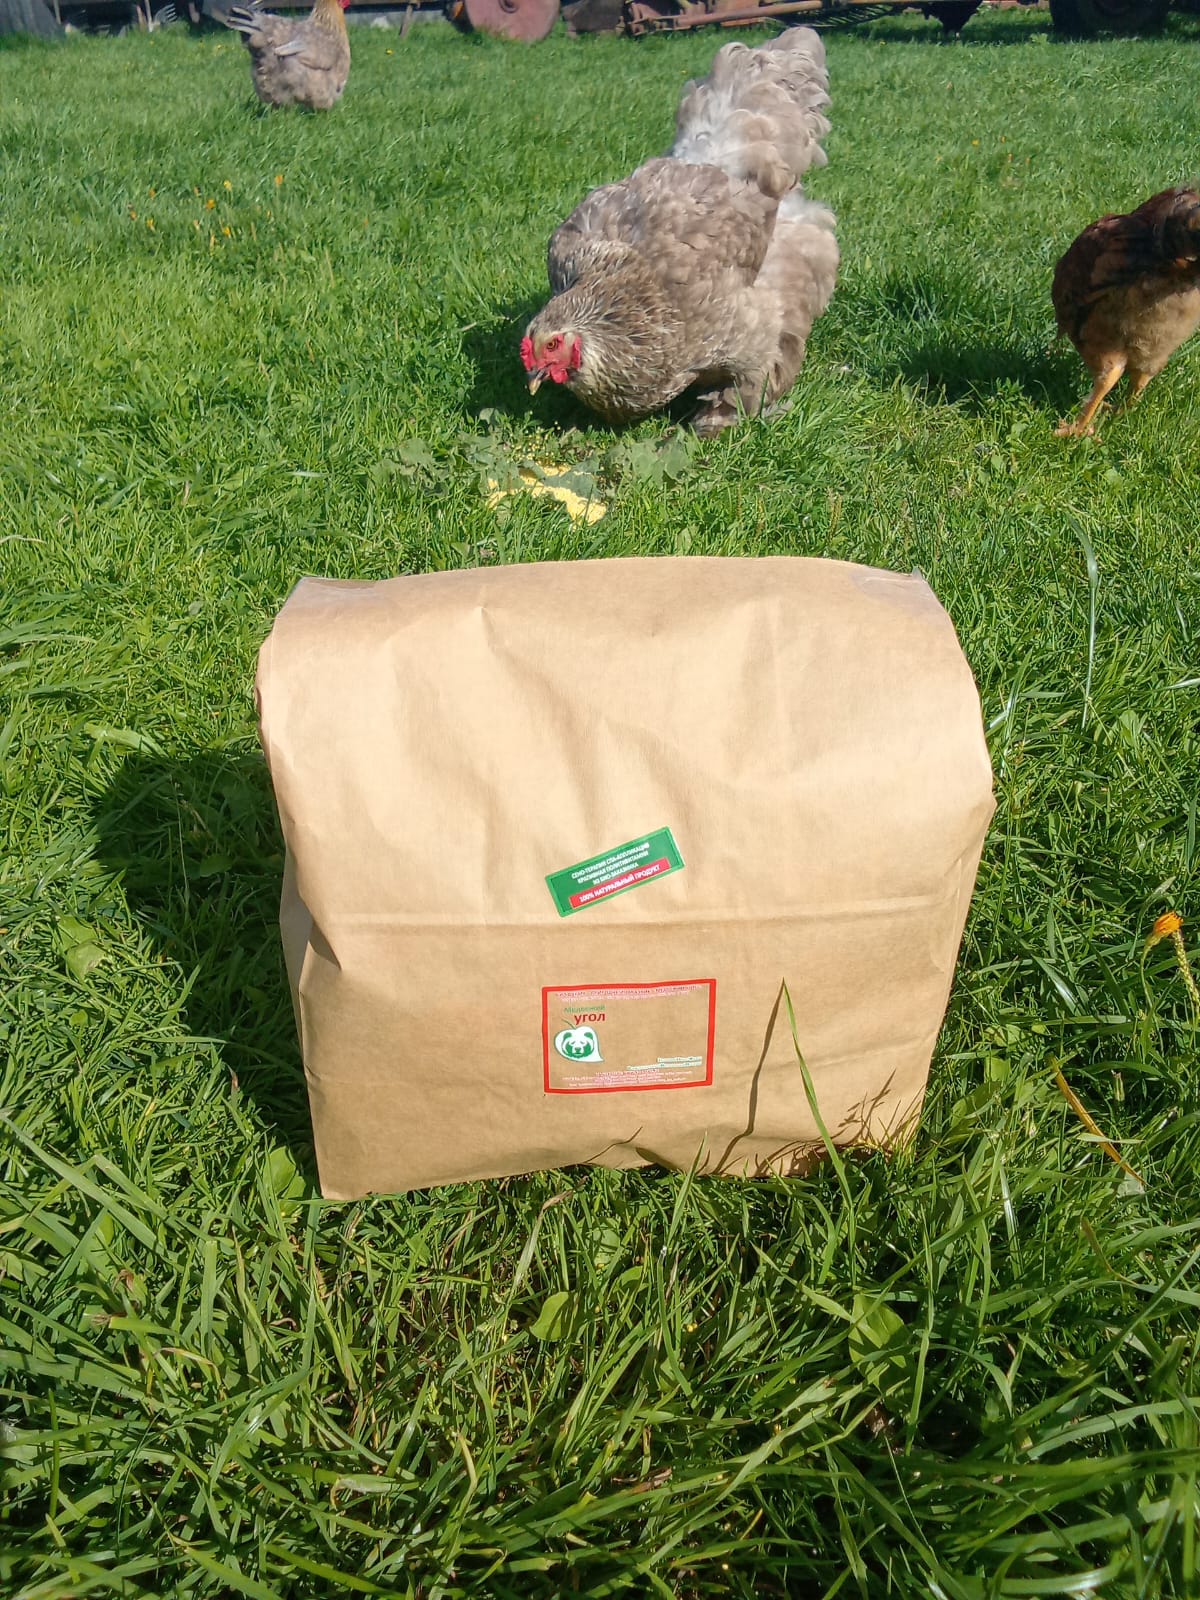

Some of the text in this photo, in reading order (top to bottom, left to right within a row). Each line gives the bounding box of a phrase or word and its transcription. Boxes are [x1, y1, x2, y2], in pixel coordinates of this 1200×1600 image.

[579, 864, 660, 902] 100% НАТУРАЛЬНЫЙ ПРОДУКТ
[574, 1013, 606, 1025] угол
